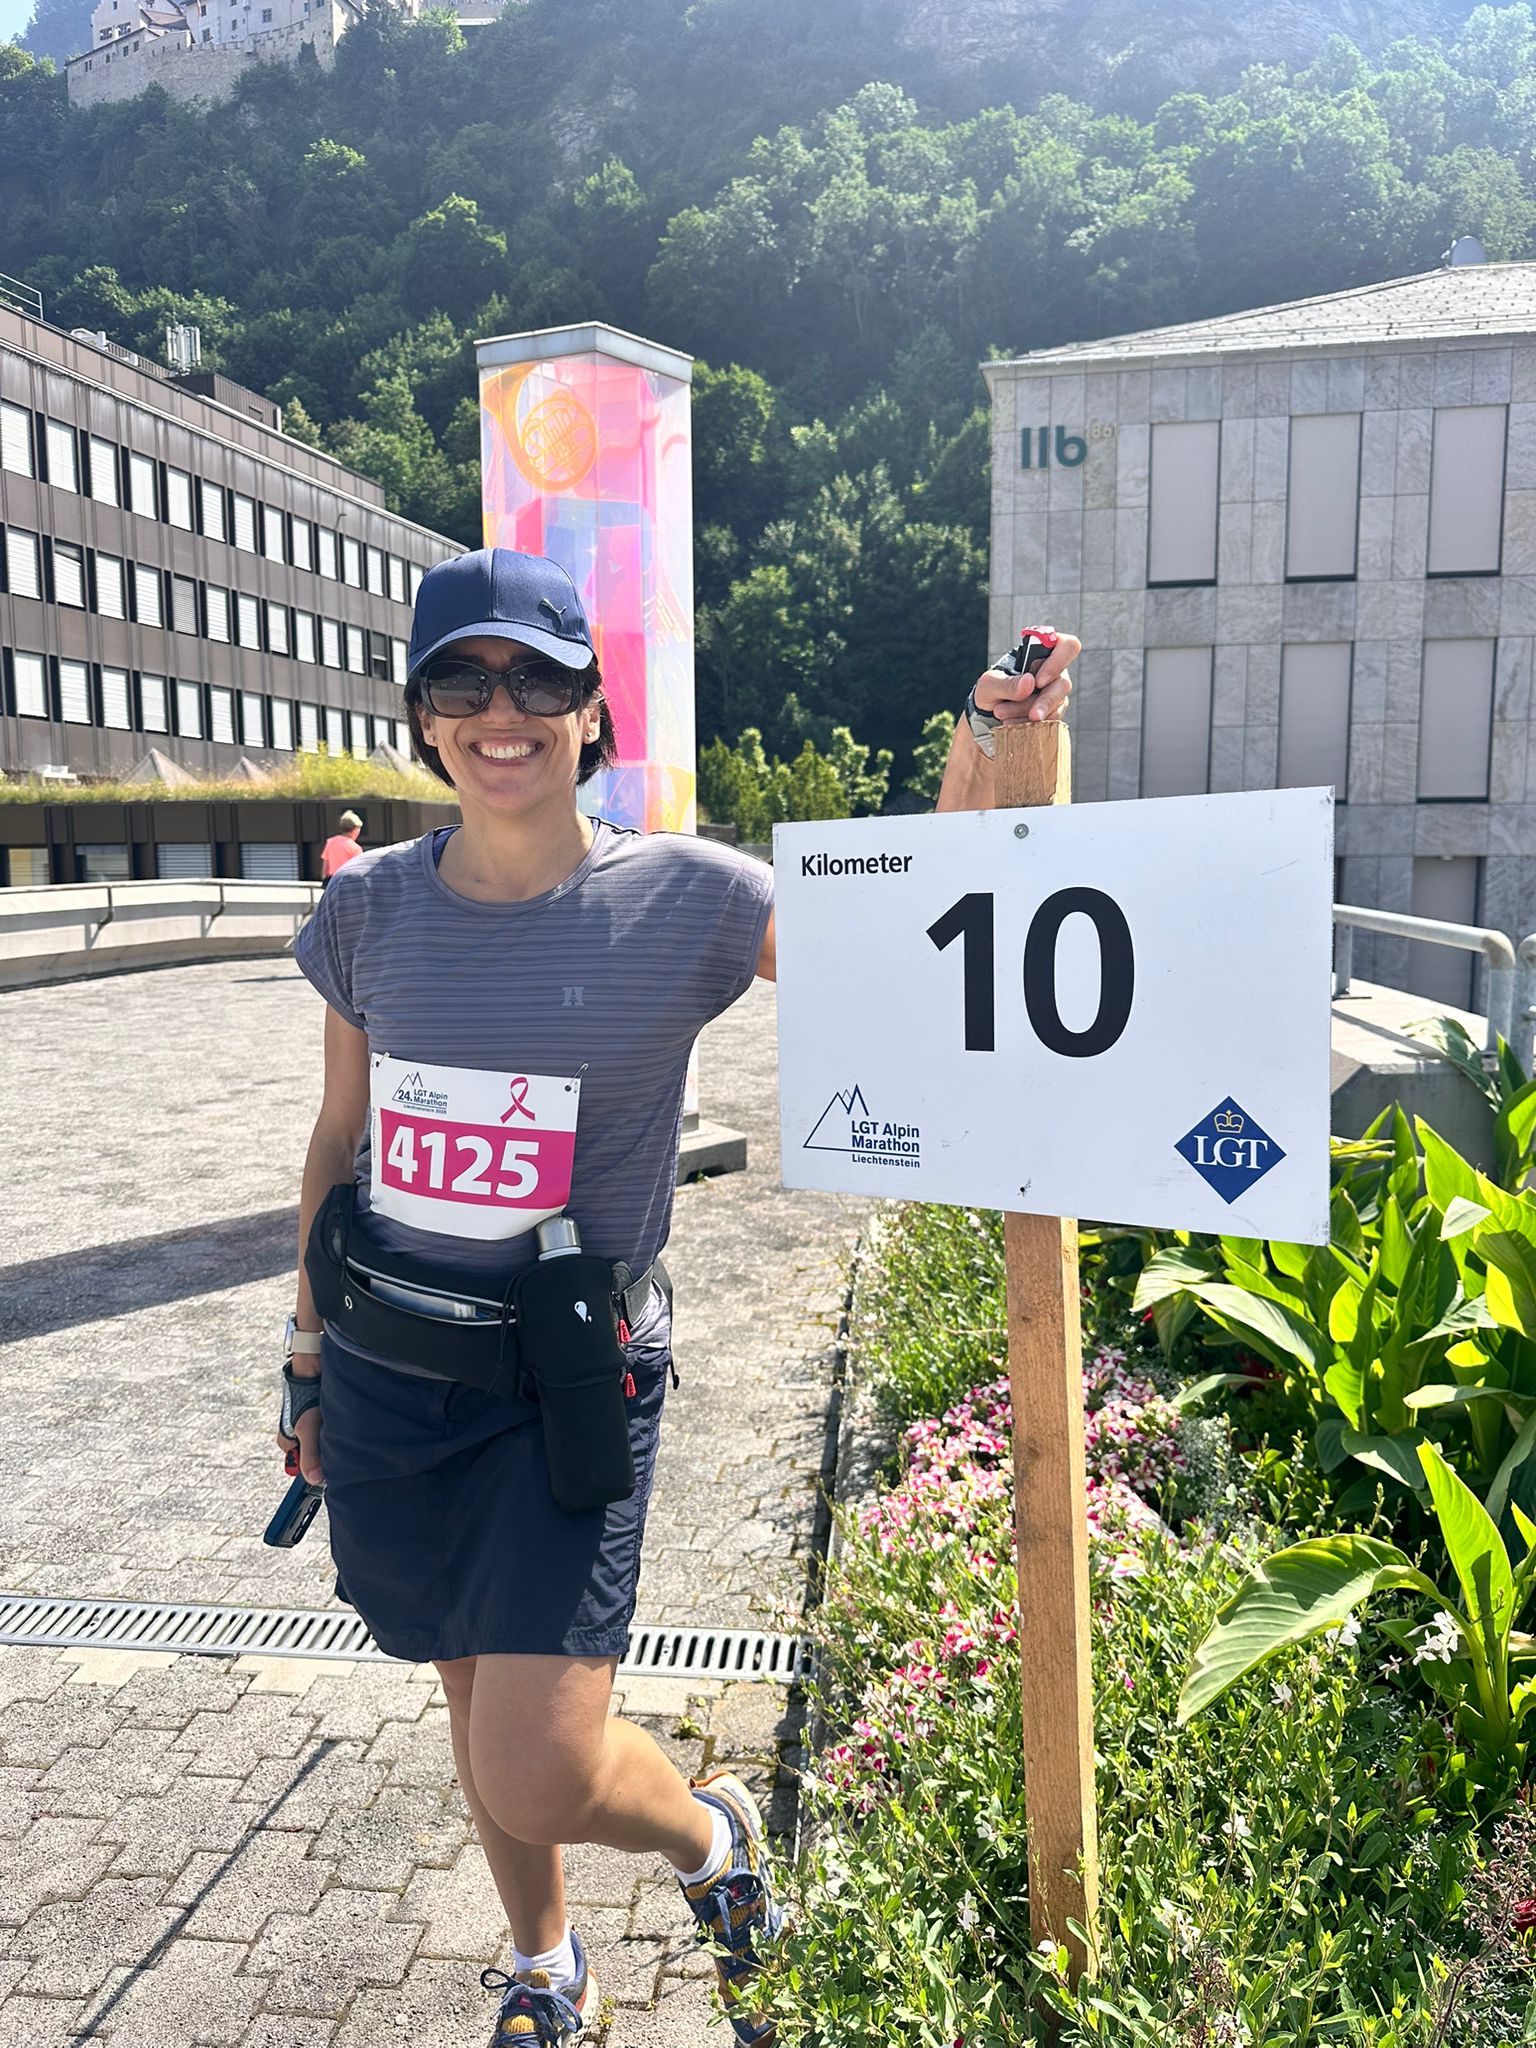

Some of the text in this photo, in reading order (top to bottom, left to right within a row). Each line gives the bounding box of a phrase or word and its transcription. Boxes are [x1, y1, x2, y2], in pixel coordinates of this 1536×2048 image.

[801, 853, 913, 877] Kilometer
[926, 886, 1135, 1058] 10
[398, 1089, 413, 1102] 24.
[413, 1089, 448, 1101] LGT Alpin
[413, 1096, 448, 1107] Marathon
[851, 1120, 920, 1139] LGT Alpin
[851, 1135, 920, 1153] Marathon
[1193, 1135, 1268, 1170] LGT
[387, 1125, 540, 1199] 4125
[851, 1154, 920, 1168] Liechtenstein
